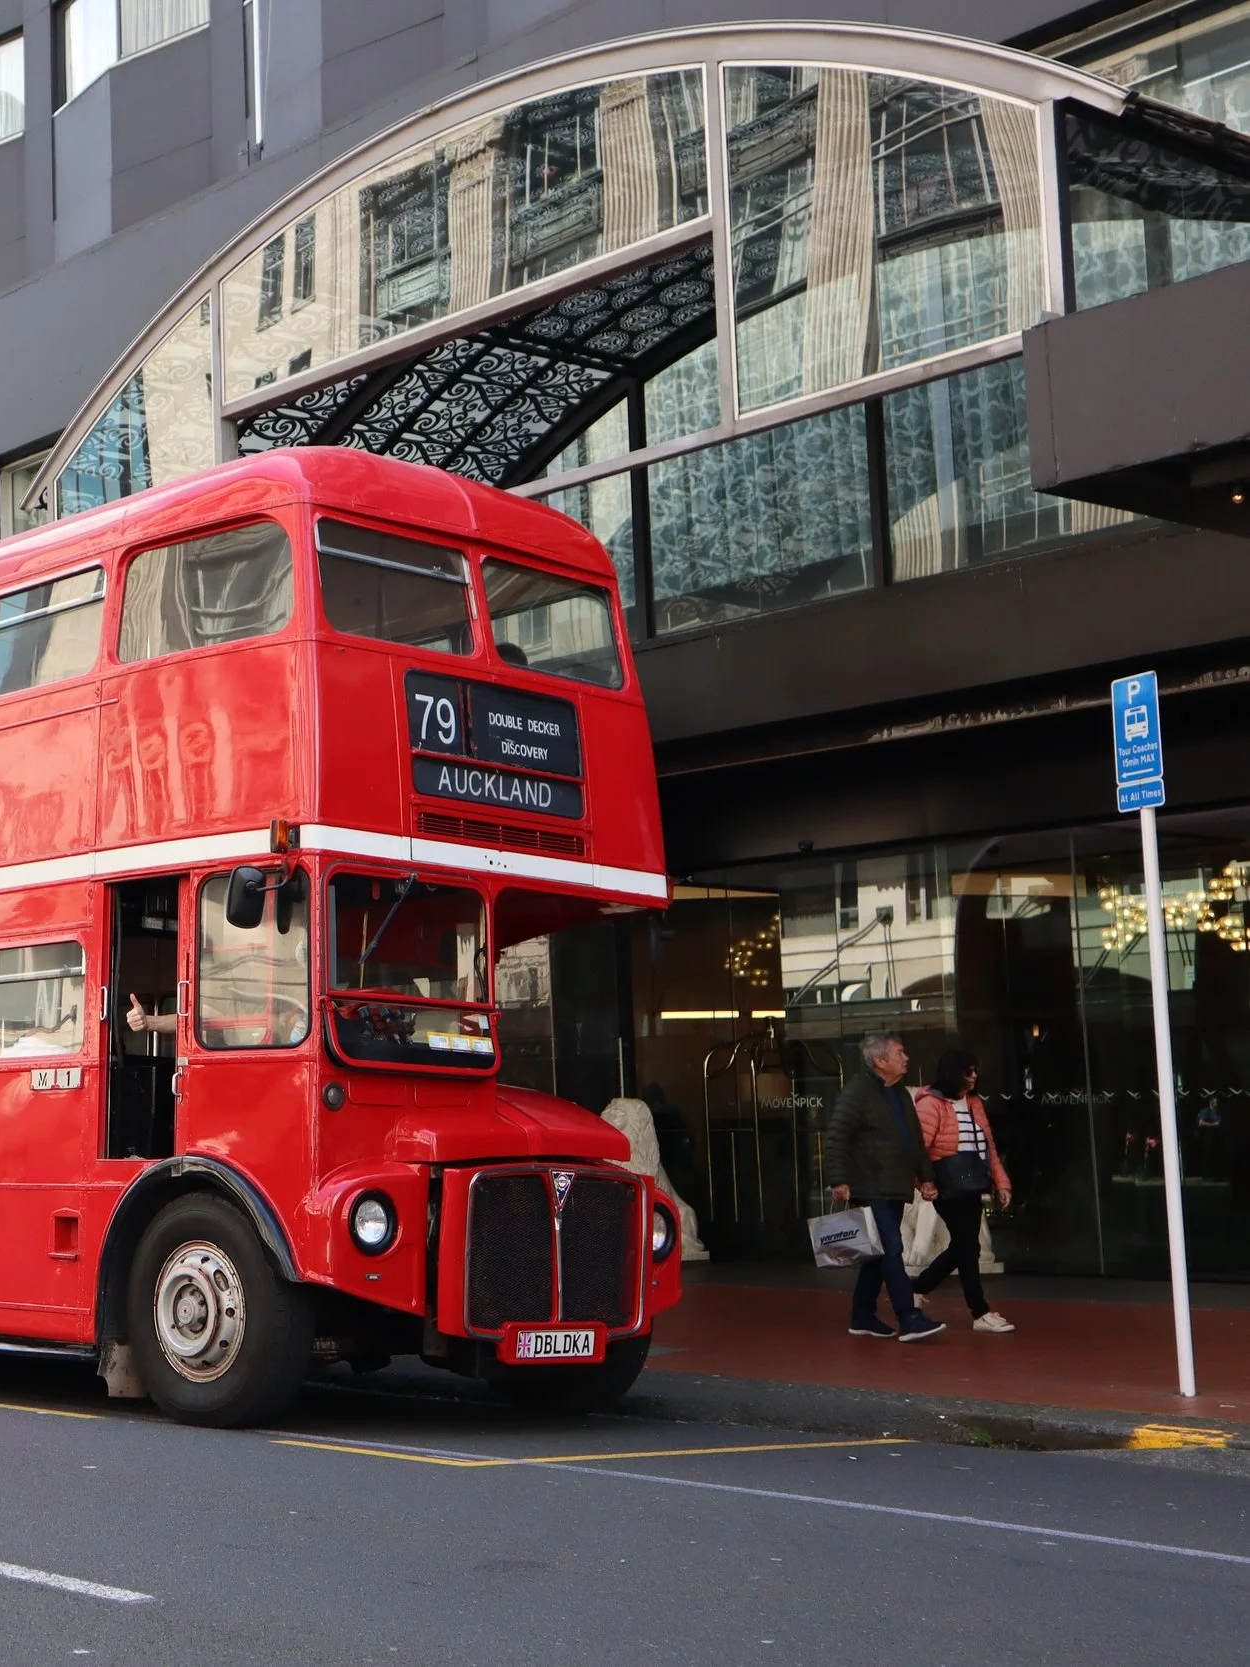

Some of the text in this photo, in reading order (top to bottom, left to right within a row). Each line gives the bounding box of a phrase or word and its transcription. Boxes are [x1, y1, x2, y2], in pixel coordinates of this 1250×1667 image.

[1128, 681, 1141, 705] P
[415, 693, 456, 745] 79
[488, 712, 561, 737] DOUBLE DECKER
[501, 741, 548, 761] DISCOVERY
[1118, 742, 1158, 757] Tour Coaches
[1122, 753, 1155, 768] 15min MAX
[438, 766, 551, 808] AUCKLAND
[1120, 788, 1161, 804] At All Times
[534, 1333, 591, 1355] DBLDKA
